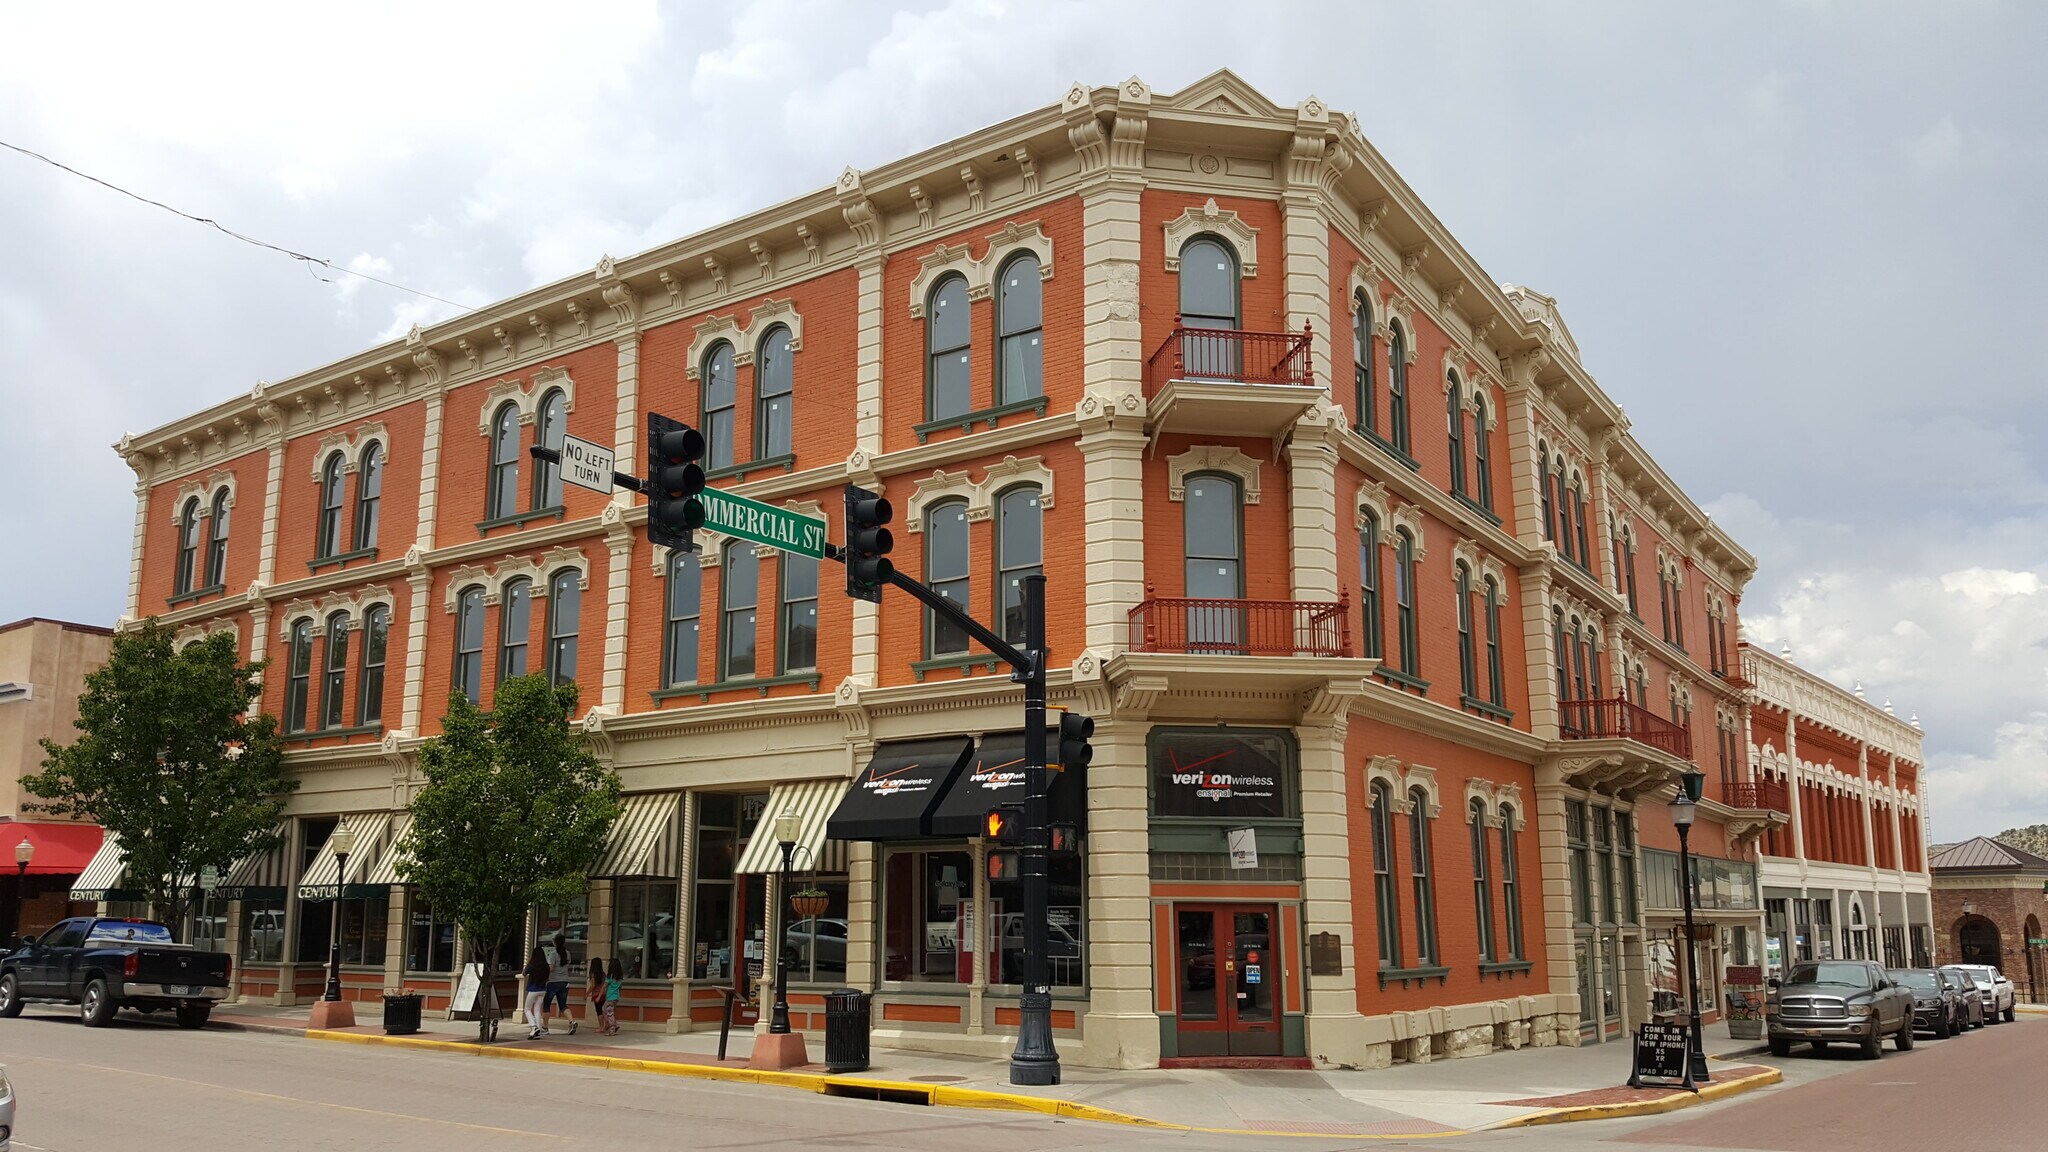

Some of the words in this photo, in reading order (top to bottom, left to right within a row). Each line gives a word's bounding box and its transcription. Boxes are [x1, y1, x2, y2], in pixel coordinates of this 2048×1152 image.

[566, 443, 582, 461] NO
[585, 452, 611, 471] LEFT
[574, 464, 600, 484] TURN
[693, 493, 799, 546] MMERCIAL
[803, 523, 823, 552] ST
[1196, 789, 1230, 801] ensignal
[70, 890, 105, 900] CENTURY
[1247, 966, 1260, 974] OPEN
[1660, 1041, 1685, 1049] IPHONE
